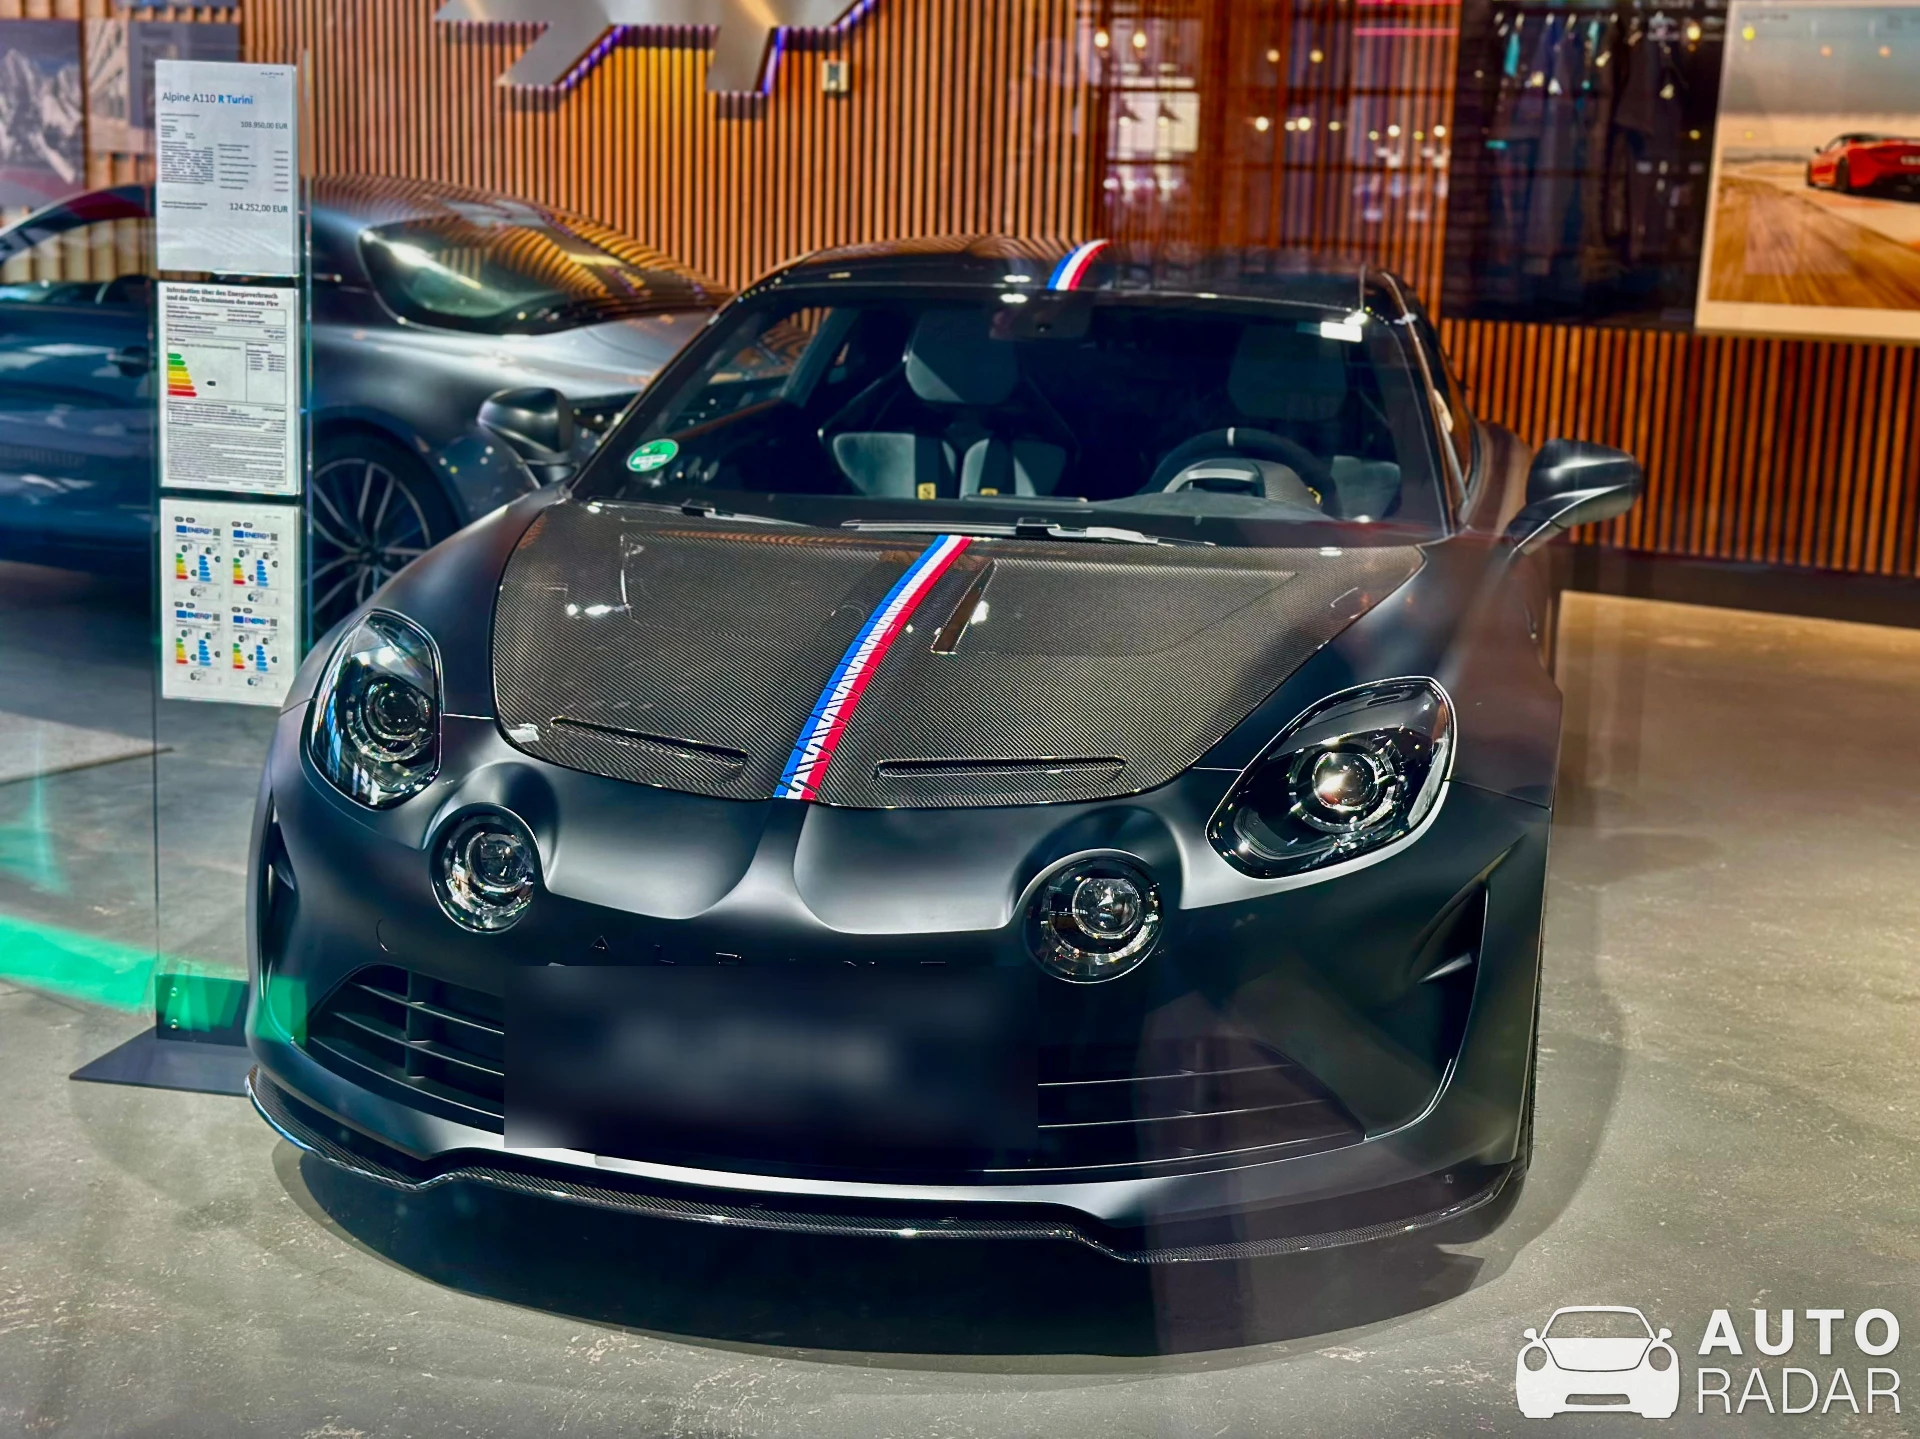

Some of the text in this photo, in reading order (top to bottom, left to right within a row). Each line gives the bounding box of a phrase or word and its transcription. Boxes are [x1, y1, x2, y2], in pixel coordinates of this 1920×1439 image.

[162, 92, 254, 104] Alpine A110 R Turini
[275, 122, 288, 130] EUR
[229, 202, 288, 213] 124.252,00 EUR
[166, 286, 200, 294] Information
[227, 290, 278, 299] Energieverbrauch
